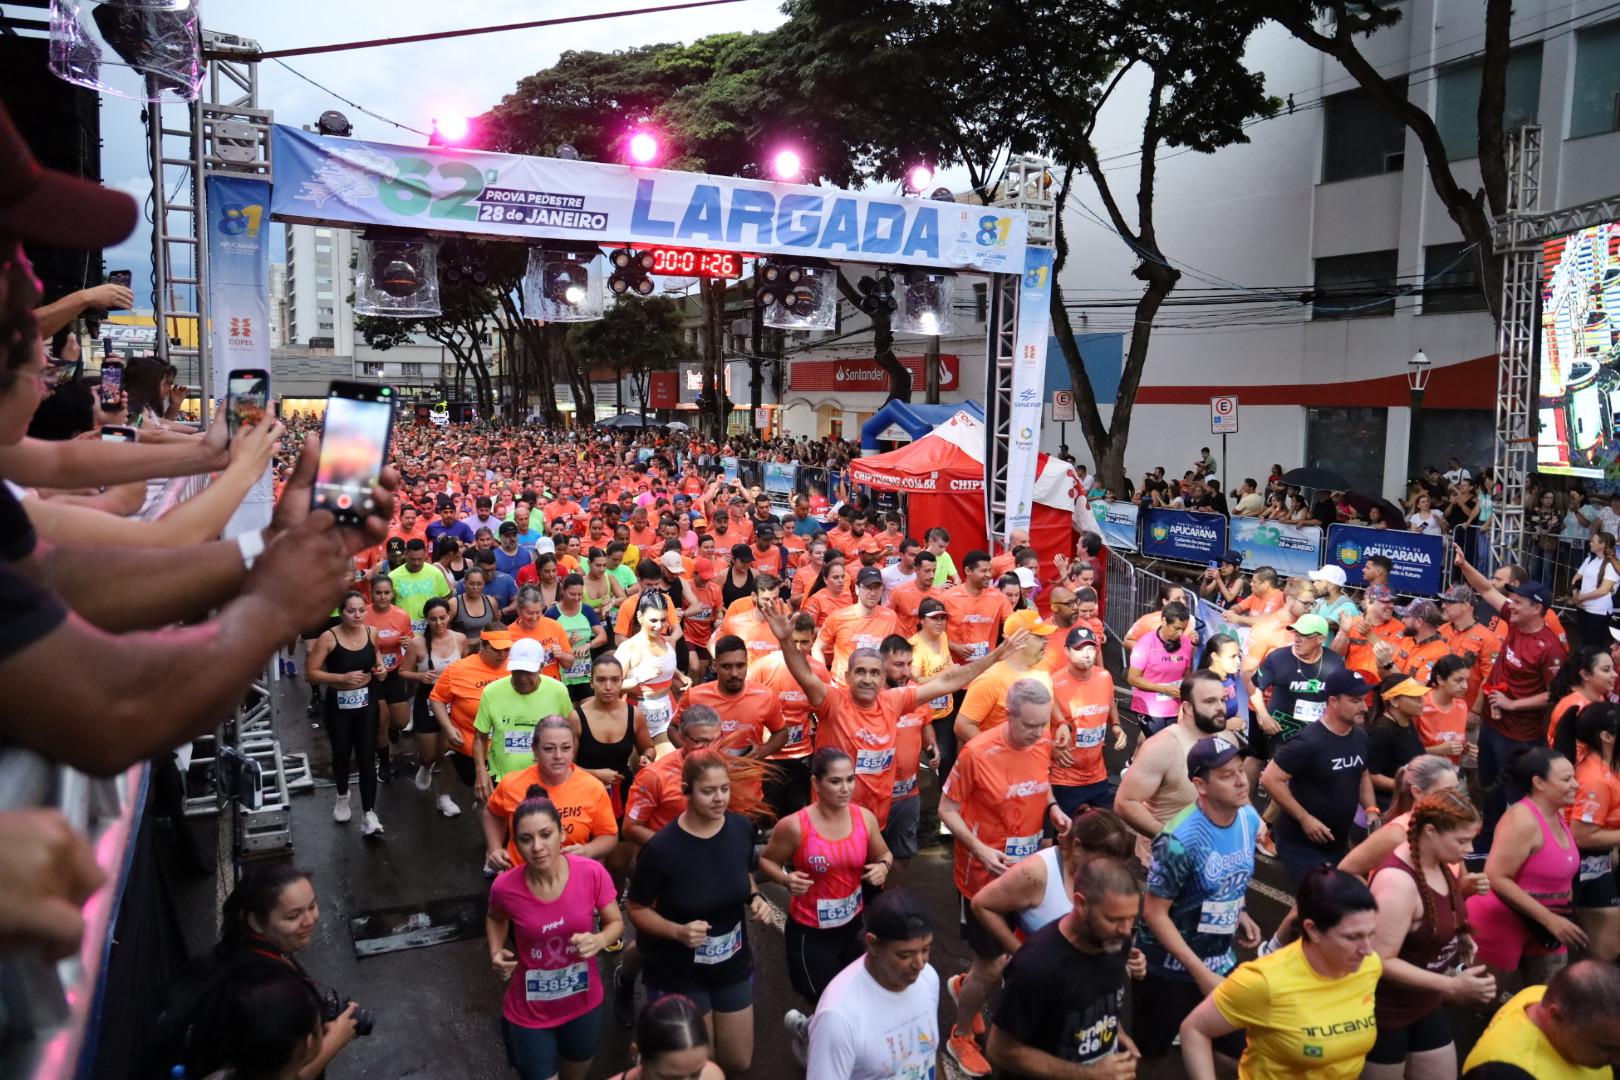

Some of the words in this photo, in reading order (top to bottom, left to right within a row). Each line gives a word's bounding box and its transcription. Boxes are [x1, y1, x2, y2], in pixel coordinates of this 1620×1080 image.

[486, 190, 525, 203] PROVA
[527, 193, 583, 208] PEDESTRE
[480, 206, 504, 222] 28
[506, 208, 524, 221] de
[526, 210, 607, 230] JANEIRO
[631, 178, 940, 259] LARGADA
[976, 214, 1012, 247] 81
[228, 338, 255, 346] COPEL
[845, 368, 885, 381] Santander
[1061, 394, 1067, 403] E
[1221, 402, 1228, 411] E
[1169, 525, 1217, 540] APUCARANA
[1374, 542, 1410, 551] PREFEITURA
[1363, 546, 1432, 565] APUCARANA
[1402, 566, 1423, 574] pessoas
[1404, 571, 1422, 579] futuro
[538, 974, 580, 992] 5853
